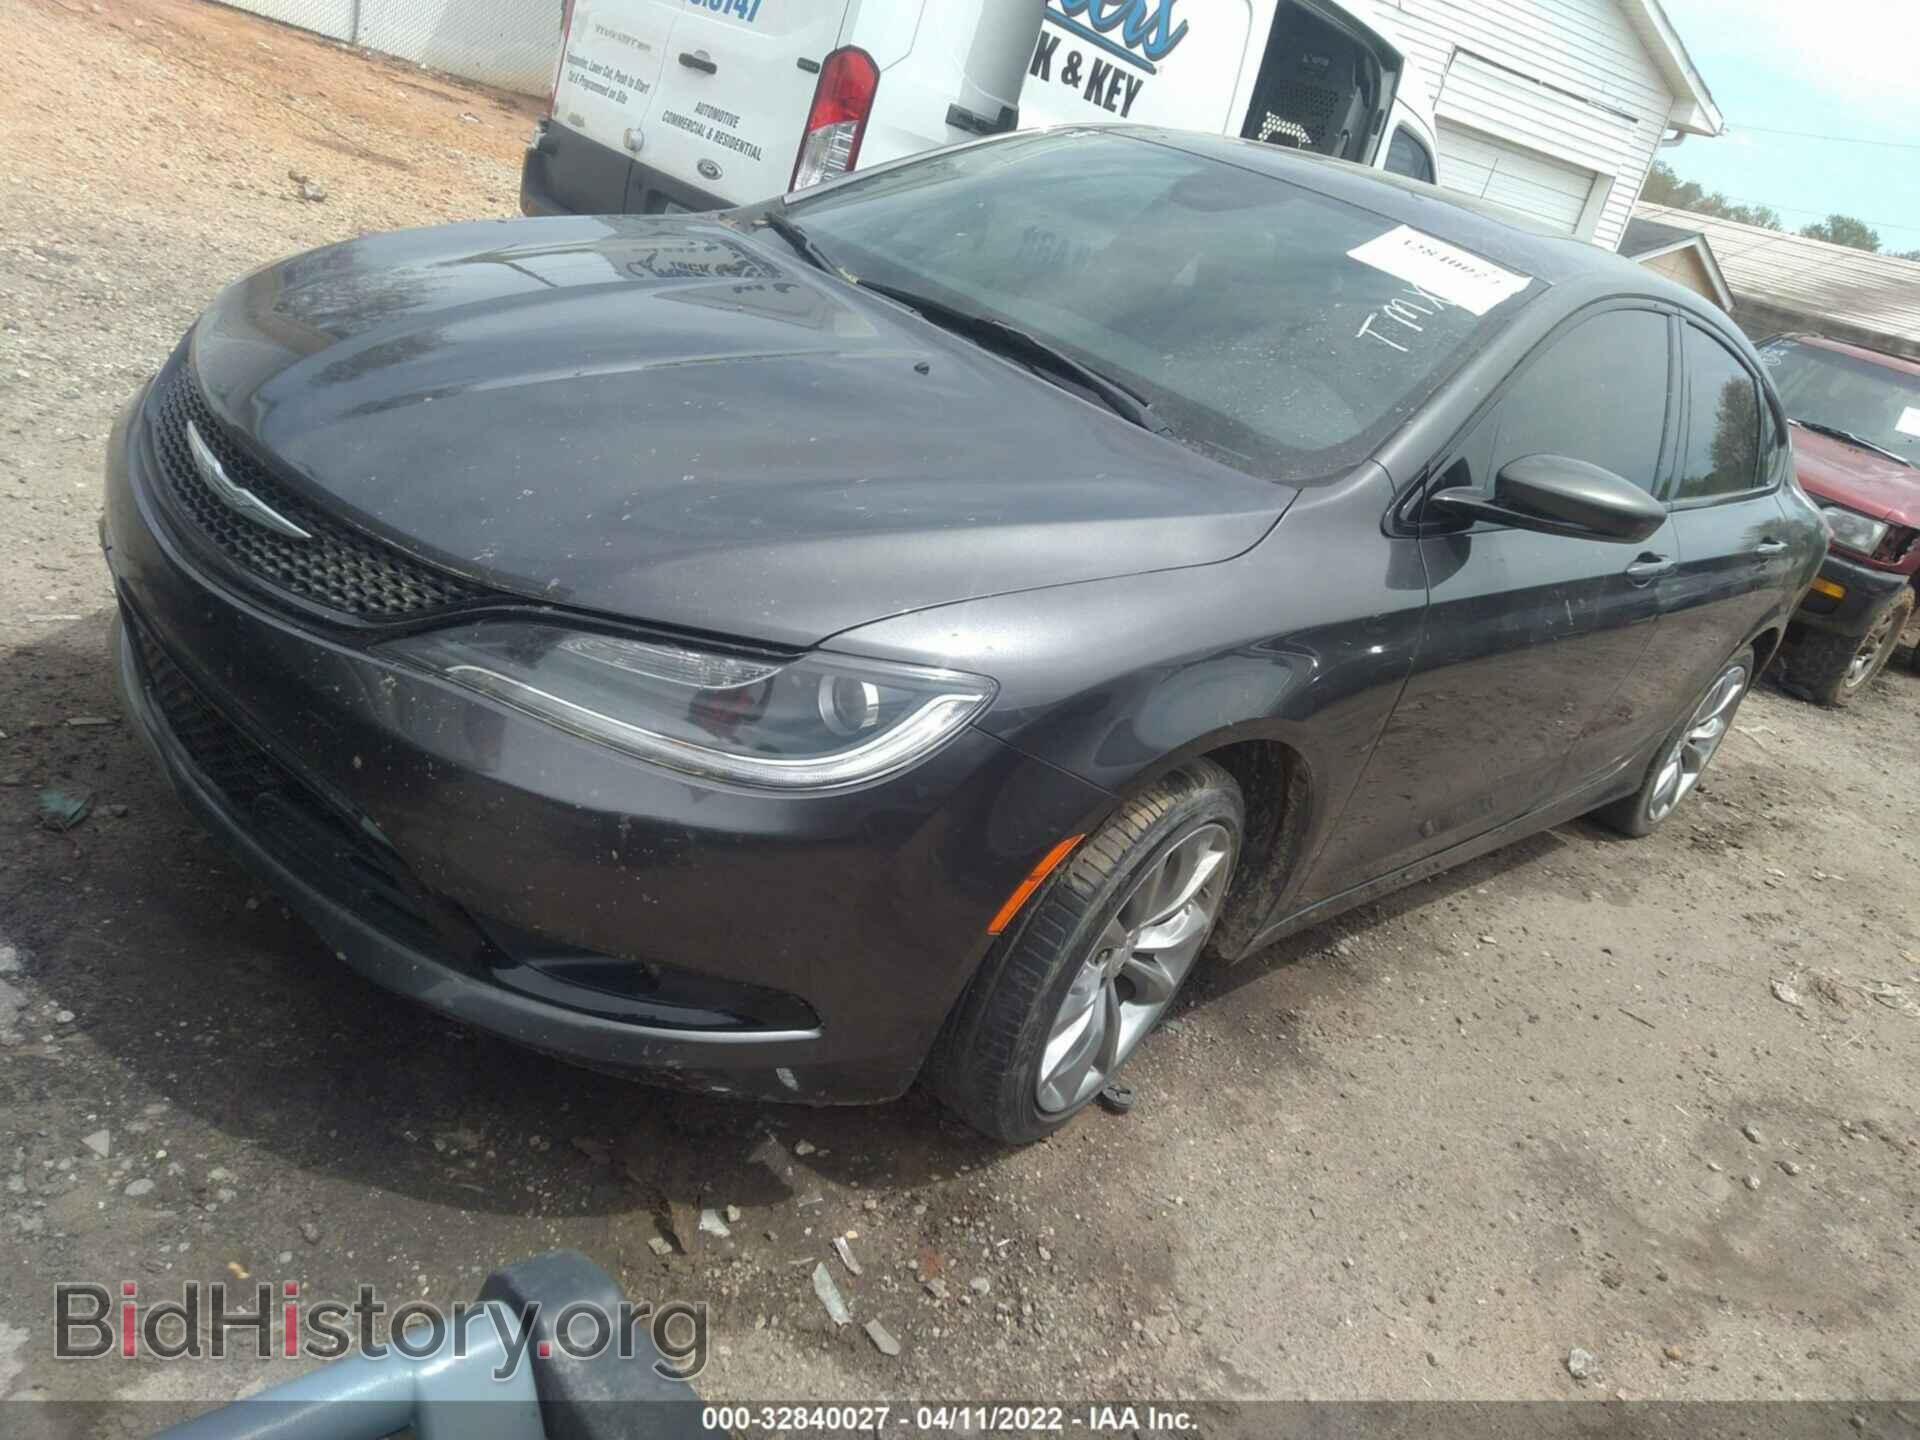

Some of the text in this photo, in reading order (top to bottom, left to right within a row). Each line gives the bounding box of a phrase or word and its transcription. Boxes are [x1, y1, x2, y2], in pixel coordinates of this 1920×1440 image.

[1061, 51, 1083, 88] &
[1083, 57, 1144, 118] KEY
[662, 110, 761, 161] COMMERCIAL & RESIDENTIAL
[695, 101, 740, 129] AUTOMOTIVE
